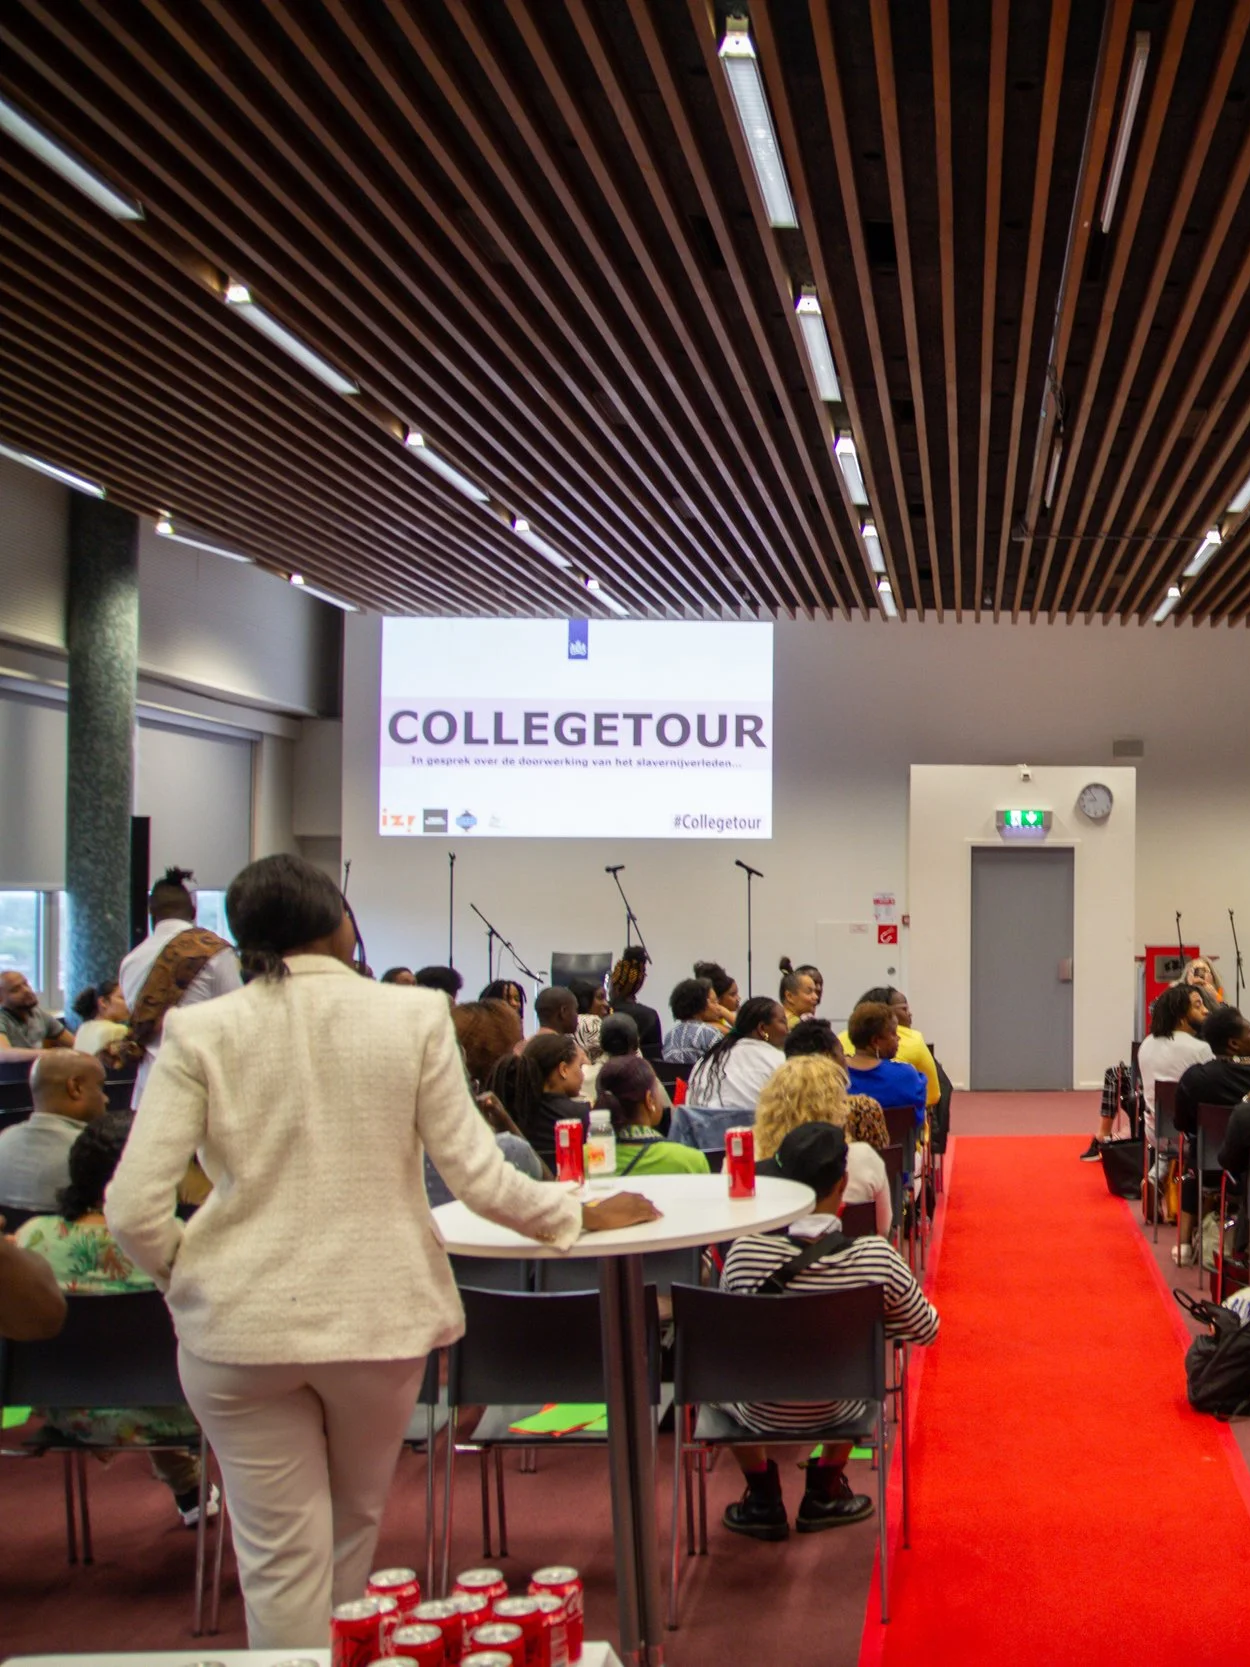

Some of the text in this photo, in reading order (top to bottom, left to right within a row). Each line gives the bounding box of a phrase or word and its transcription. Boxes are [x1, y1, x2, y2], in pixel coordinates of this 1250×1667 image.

[387, 709, 768, 749] COLLEGETOUR
[410, 756, 423, 765] In
[426, 756, 470, 768] gesprek
[474, 758, 498, 766] over
[502, 756, 515, 766] de
[518, 757, 588, 768] doorwerking
[592, 758, 612, 767] van
[615, 757, 633, 767] het
[673, 813, 762, 833] #Collegetour
